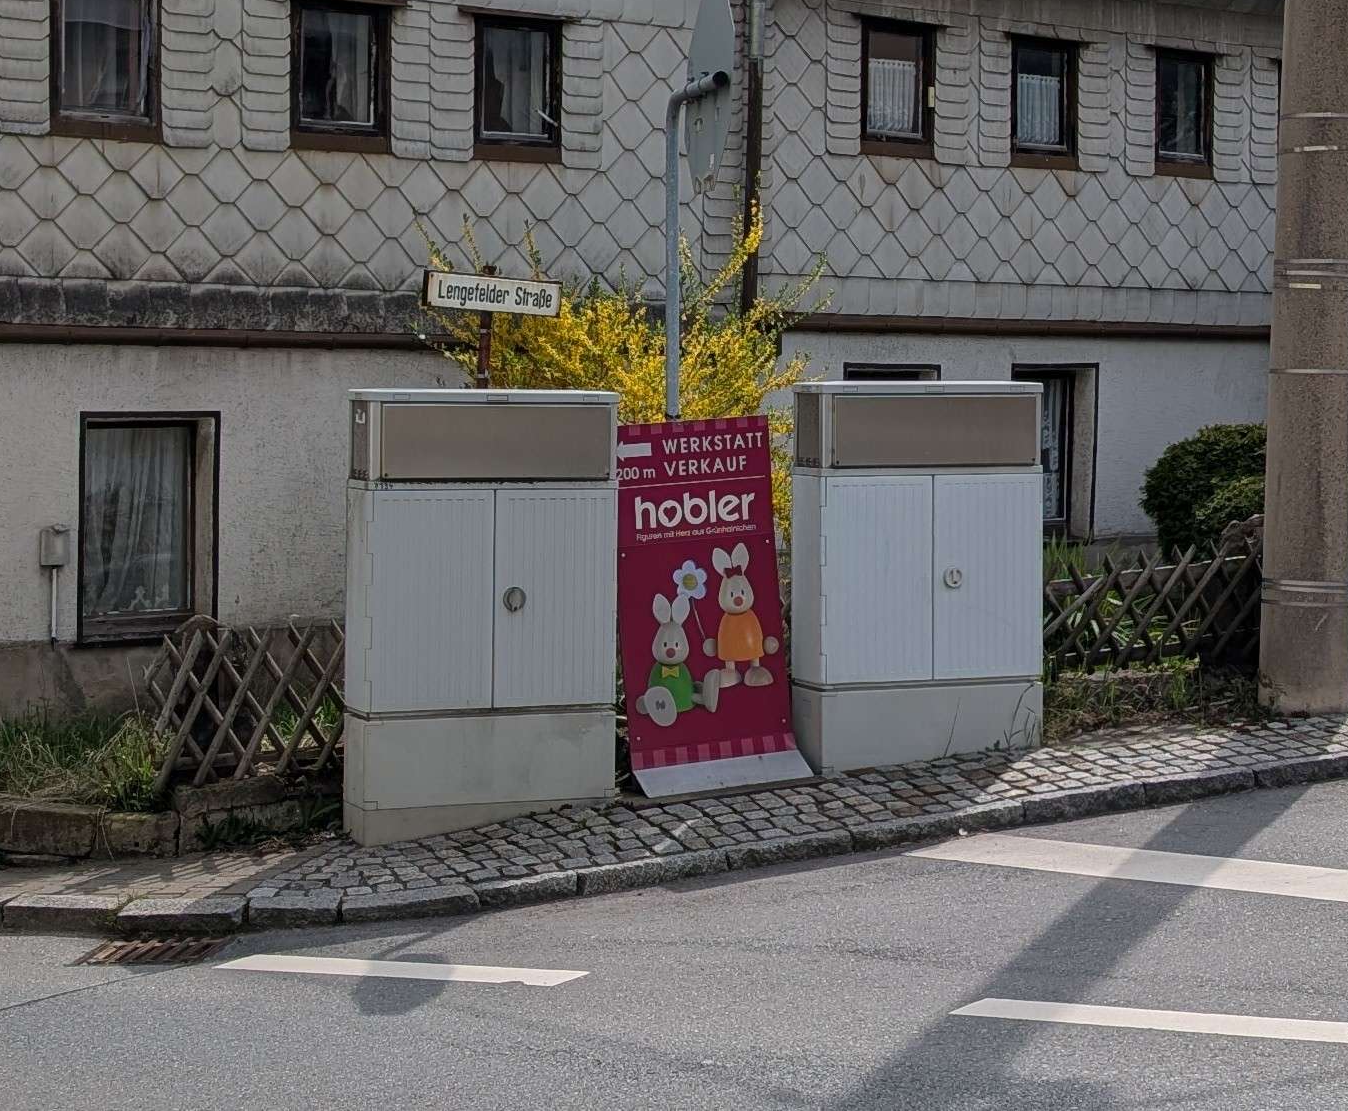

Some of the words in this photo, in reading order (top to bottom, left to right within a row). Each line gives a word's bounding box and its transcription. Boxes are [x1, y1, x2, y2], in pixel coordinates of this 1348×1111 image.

[437, 280, 510, 306] Lengefelder
[514, 286, 552, 309] Straße
[662, 432, 763, 455] WERKSTATT
[616, 467, 640, 480] 200
[643, 468, 656, 479] m
[664, 455, 747, 477] VERKAUF
[634, 490, 756, 530] hobler
